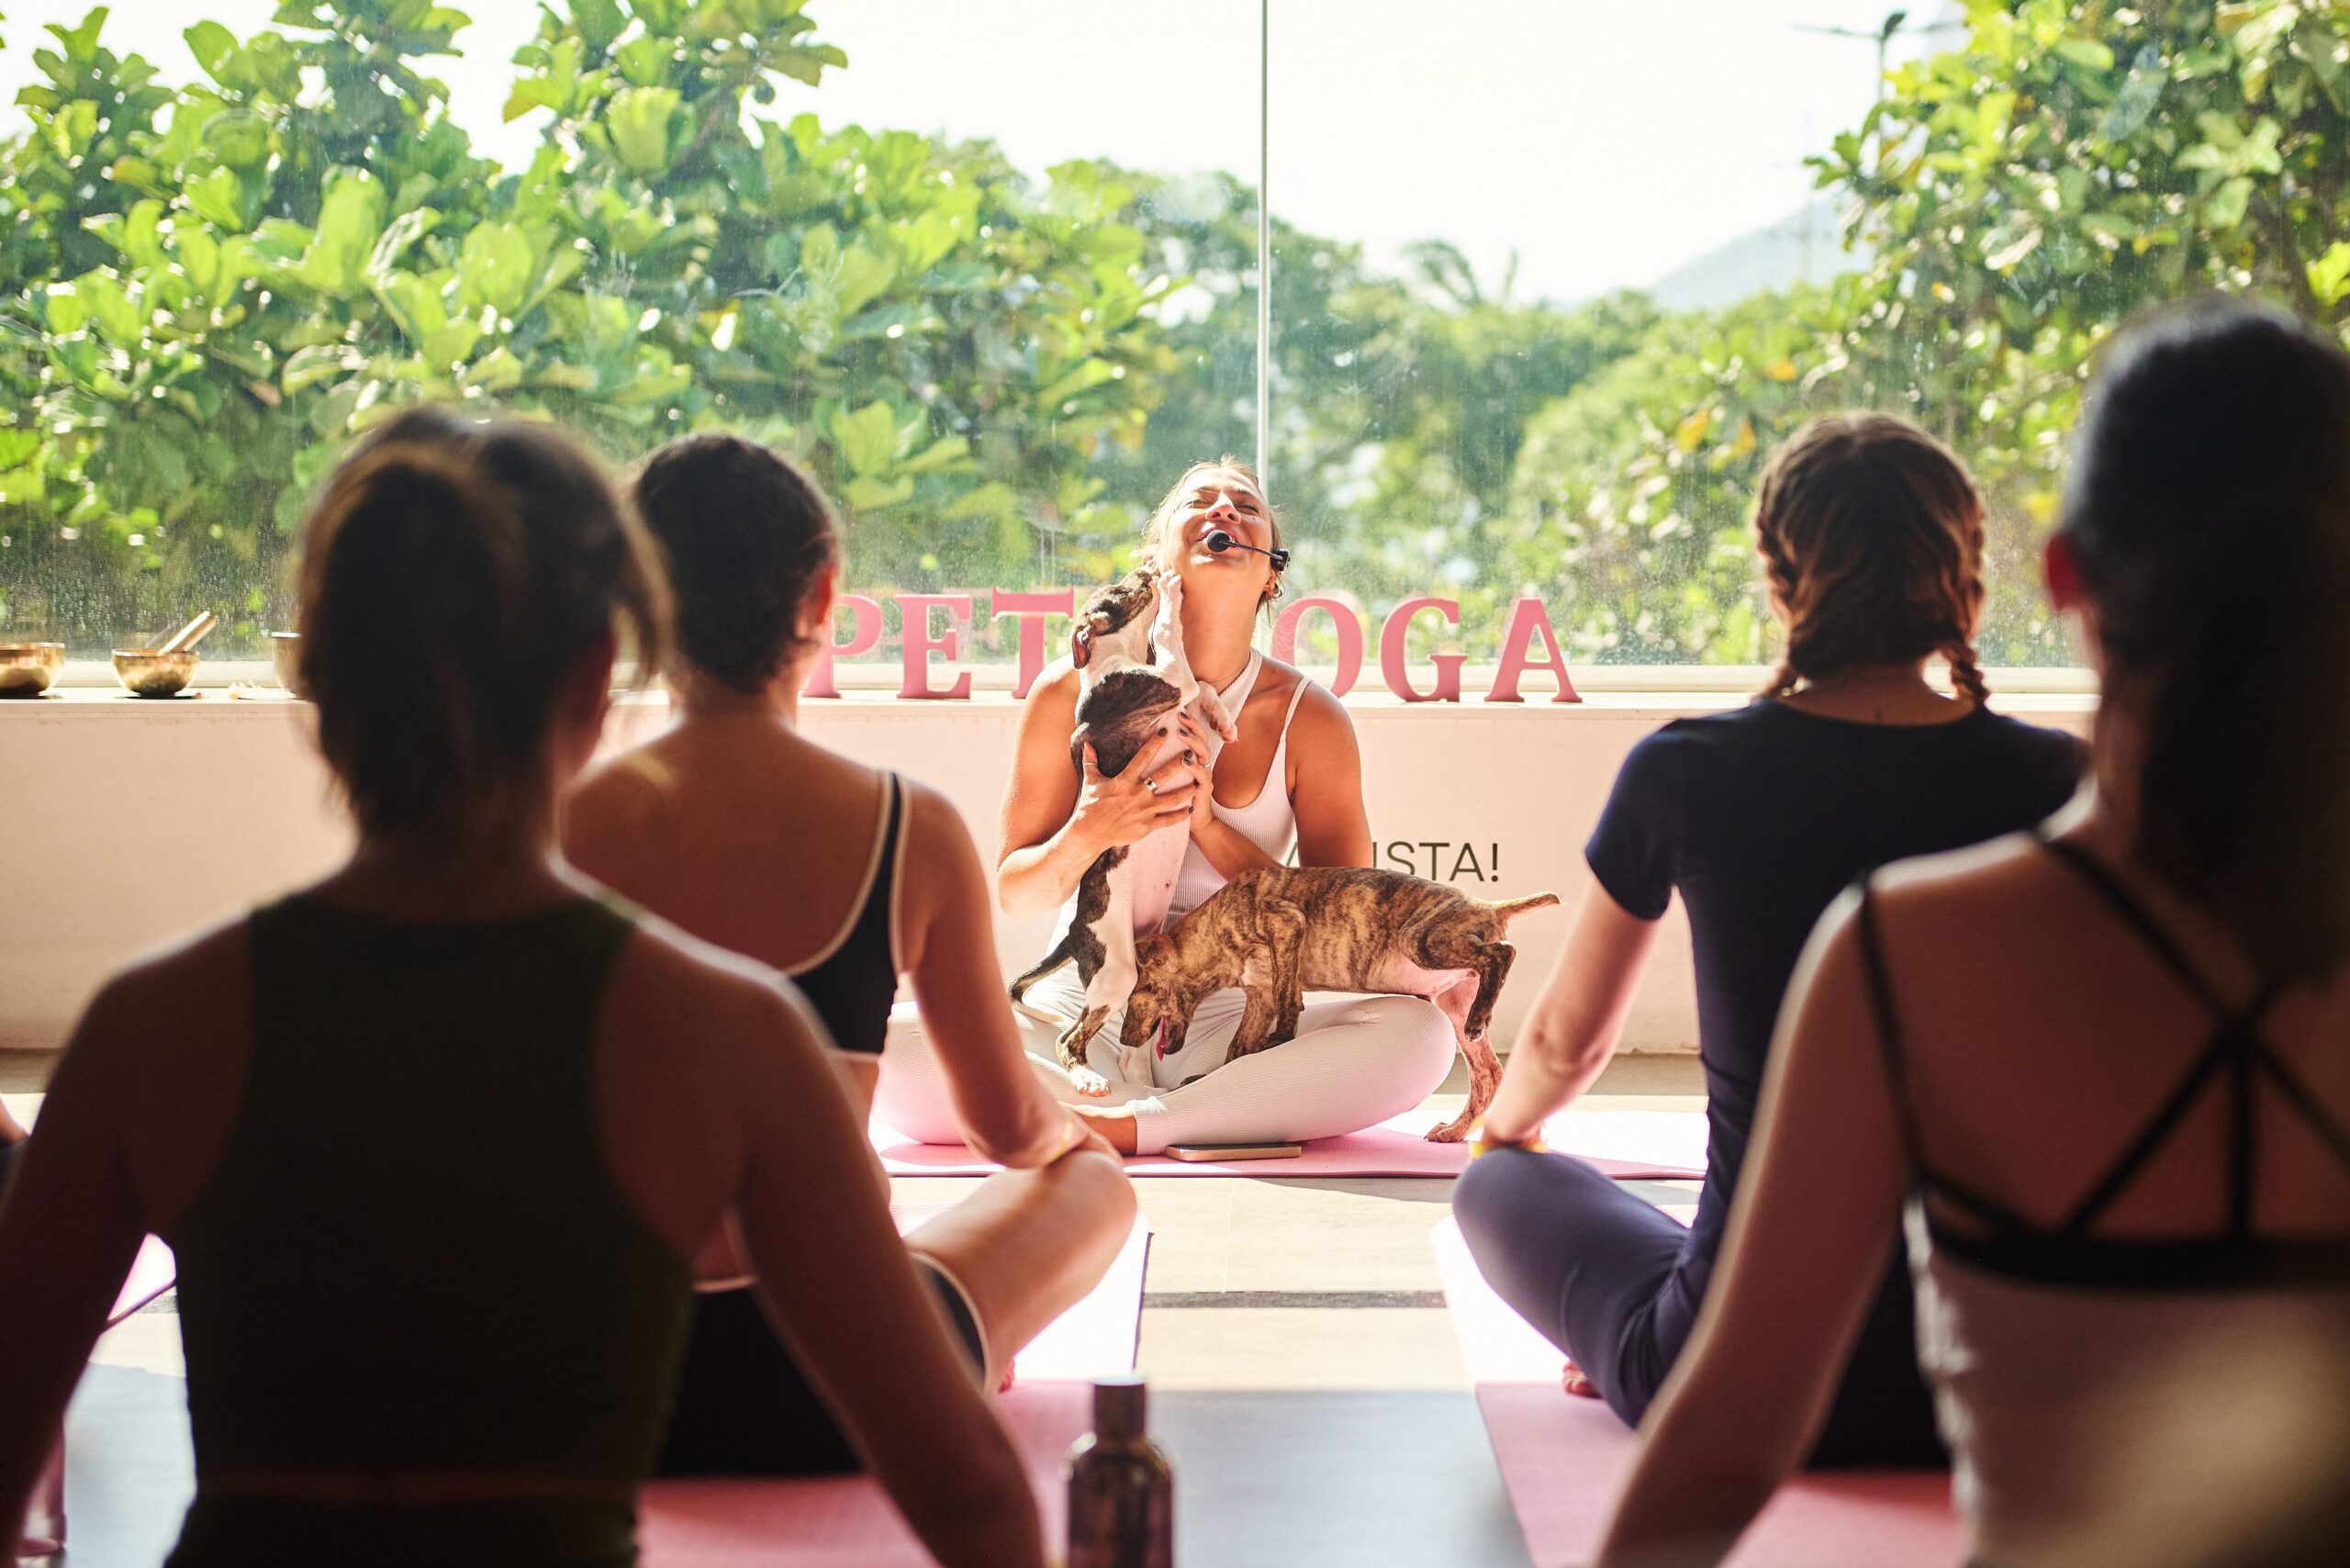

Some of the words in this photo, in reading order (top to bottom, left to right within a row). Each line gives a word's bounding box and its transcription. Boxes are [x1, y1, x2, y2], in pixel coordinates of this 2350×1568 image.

[801, 588, 1075, 700] PET
[1270, 597, 1583, 702] OGA
[1286, 841, 1499, 882] ISTA!
